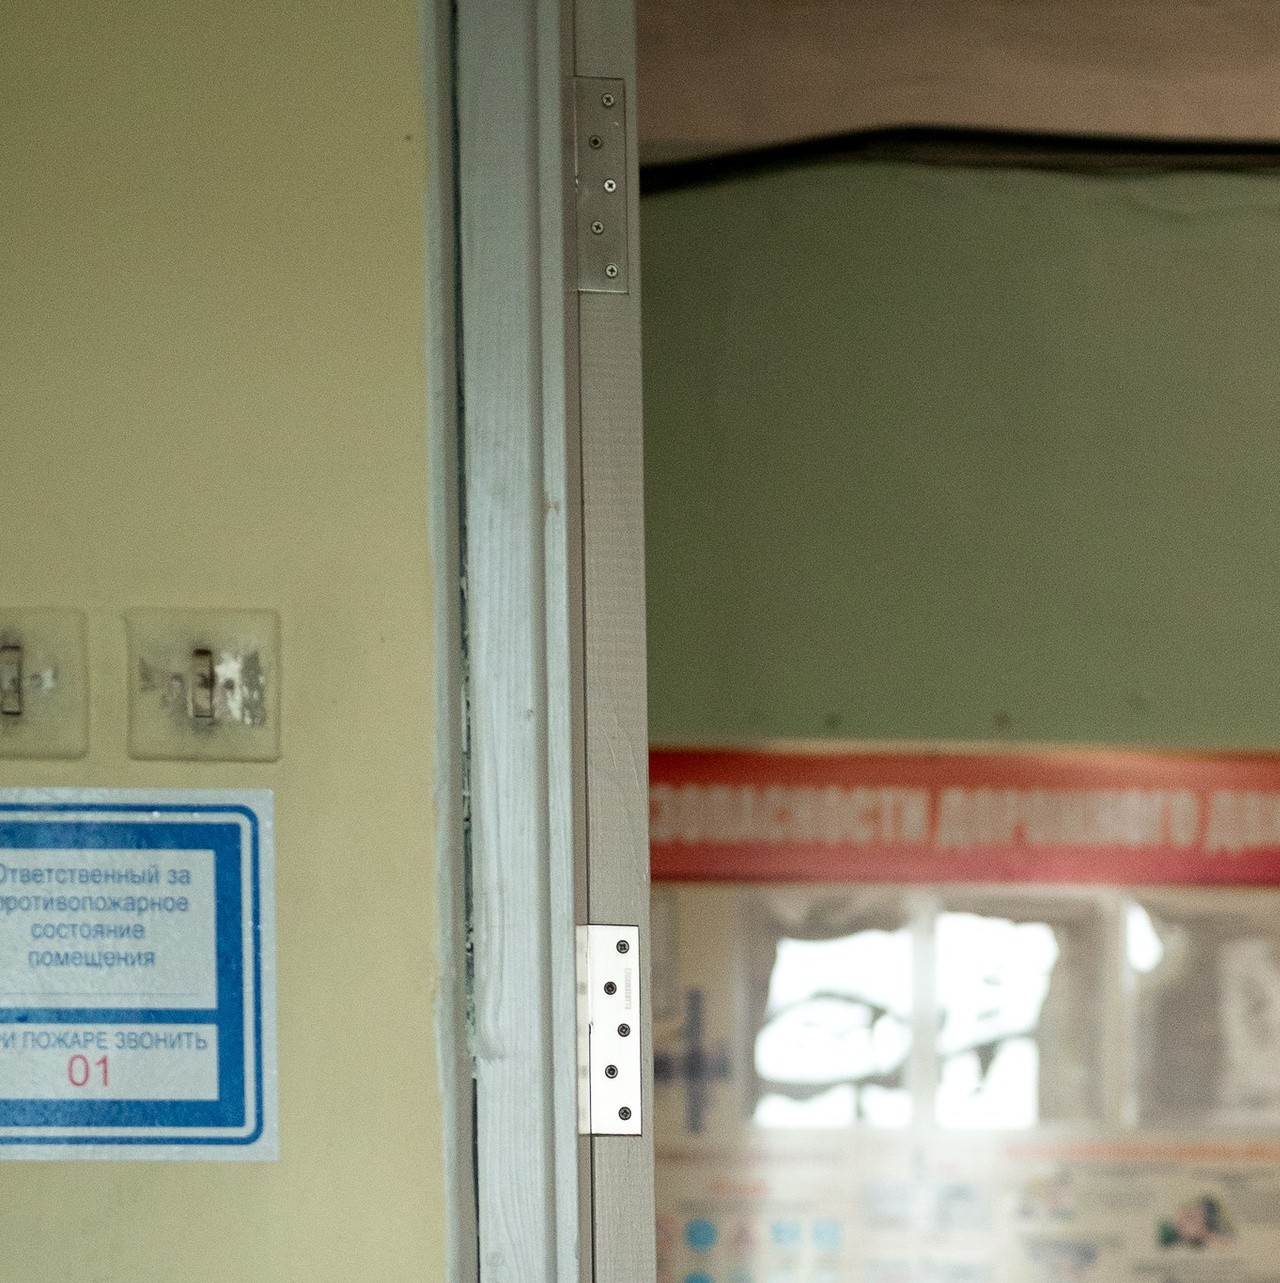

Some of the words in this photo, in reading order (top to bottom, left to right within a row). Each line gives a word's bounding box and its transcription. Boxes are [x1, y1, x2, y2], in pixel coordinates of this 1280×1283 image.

[167, 868, 191, 885] за
[0, 895, 189, 916] ротивопожарное
[30, 923, 145, 939] состояние
[28, 950, 156, 968] помещения
[23, 1031, 108, 1049] ПОЖАРЕ
[115, 1031, 208, 1050] ЗВОНИТЬ
[67, 1053, 109, 1087] 01
